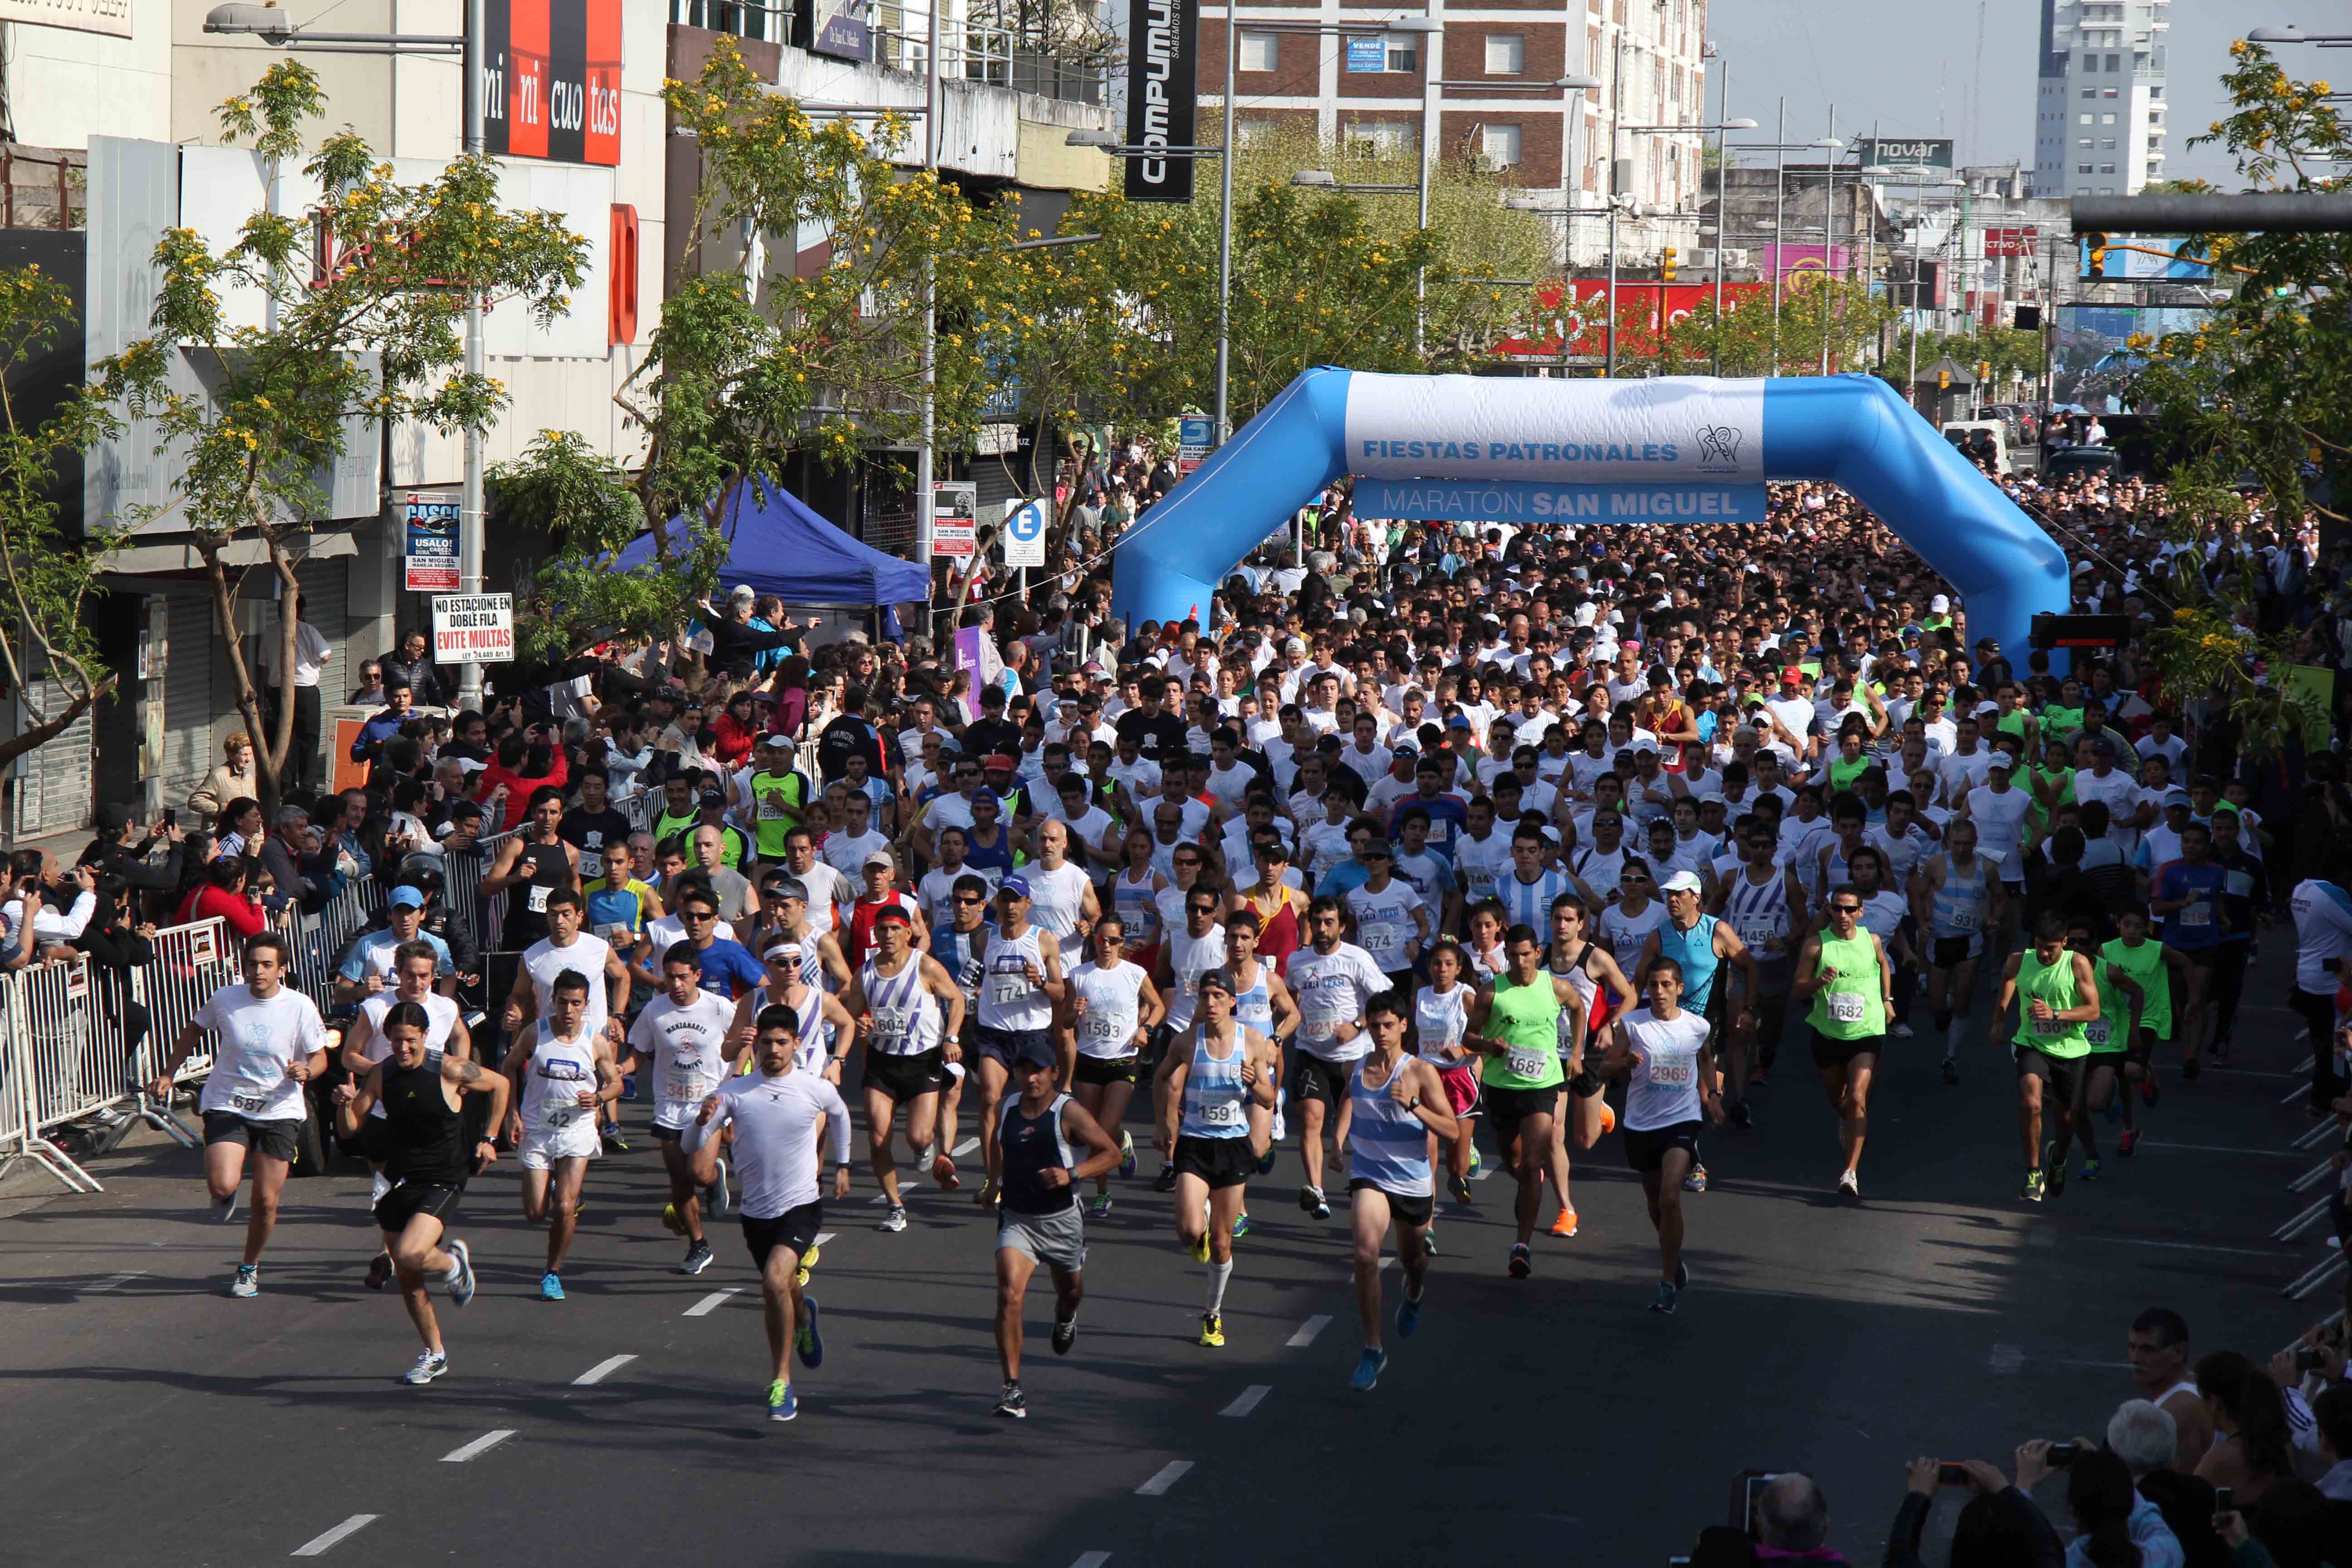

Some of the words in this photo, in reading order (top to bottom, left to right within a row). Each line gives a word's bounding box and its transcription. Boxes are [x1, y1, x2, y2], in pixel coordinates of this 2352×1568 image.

[1171, 13, 1180, 59] SABEMOS
[520, 60, 538, 125] ni
[551, 79, 583, 132] cuo
[591, 76, 617, 136] tas
[1877, 143, 1939, 157] novar
[1363, 440, 1480, 460] FIESTAS
[1490, 442, 1678, 462] PATRONALES
[1383, 486, 1523, 514] MARATÓN
[1533, 493, 1599, 516] SAN
[1611, 493, 1739, 515] MIGUEL
[1018, 509, 1033, 534] E
[415, 539, 453, 548] USALO!
[436, 600, 448, 613] NO
[450, 598, 498, 612] ESTACIONE
[500, 597, 511, 610] EN
[450, 613, 478, 627] DOBLE
[480, 613, 498, 626] FILA
[437, 631, 466, 650] EVITE
[469, 628, 510, 648] MULTAS
[1662, 754, 1676, 763] 20
[583, 862, 598, 874] 12
[529, 896, 546, 909] 16
[1125, 922, 1140, 934] 94
[1955, 914, 1977, 929] 931
[1365, 935, 1391, 949] 674
[1322, 979, 1345, 988] TEAM
[995, 987, 1024, 1002] 774
[1828, 1005, 1863, 1018] 1682
[666, 1022, 708, 1035] MANZANARES
[1085, 1022, 1120, 1038] 1593
[1507, 1057, 1545, 1075] 1687
[1651, 1066, 1688, 1082] 2969
[668, 1082, 704, 1099] 3467
[233, 1095, 268, 1113] 687
[548, 1112, 570, 1127] 42
[1199, 1105, 1238, 1121] 1591
